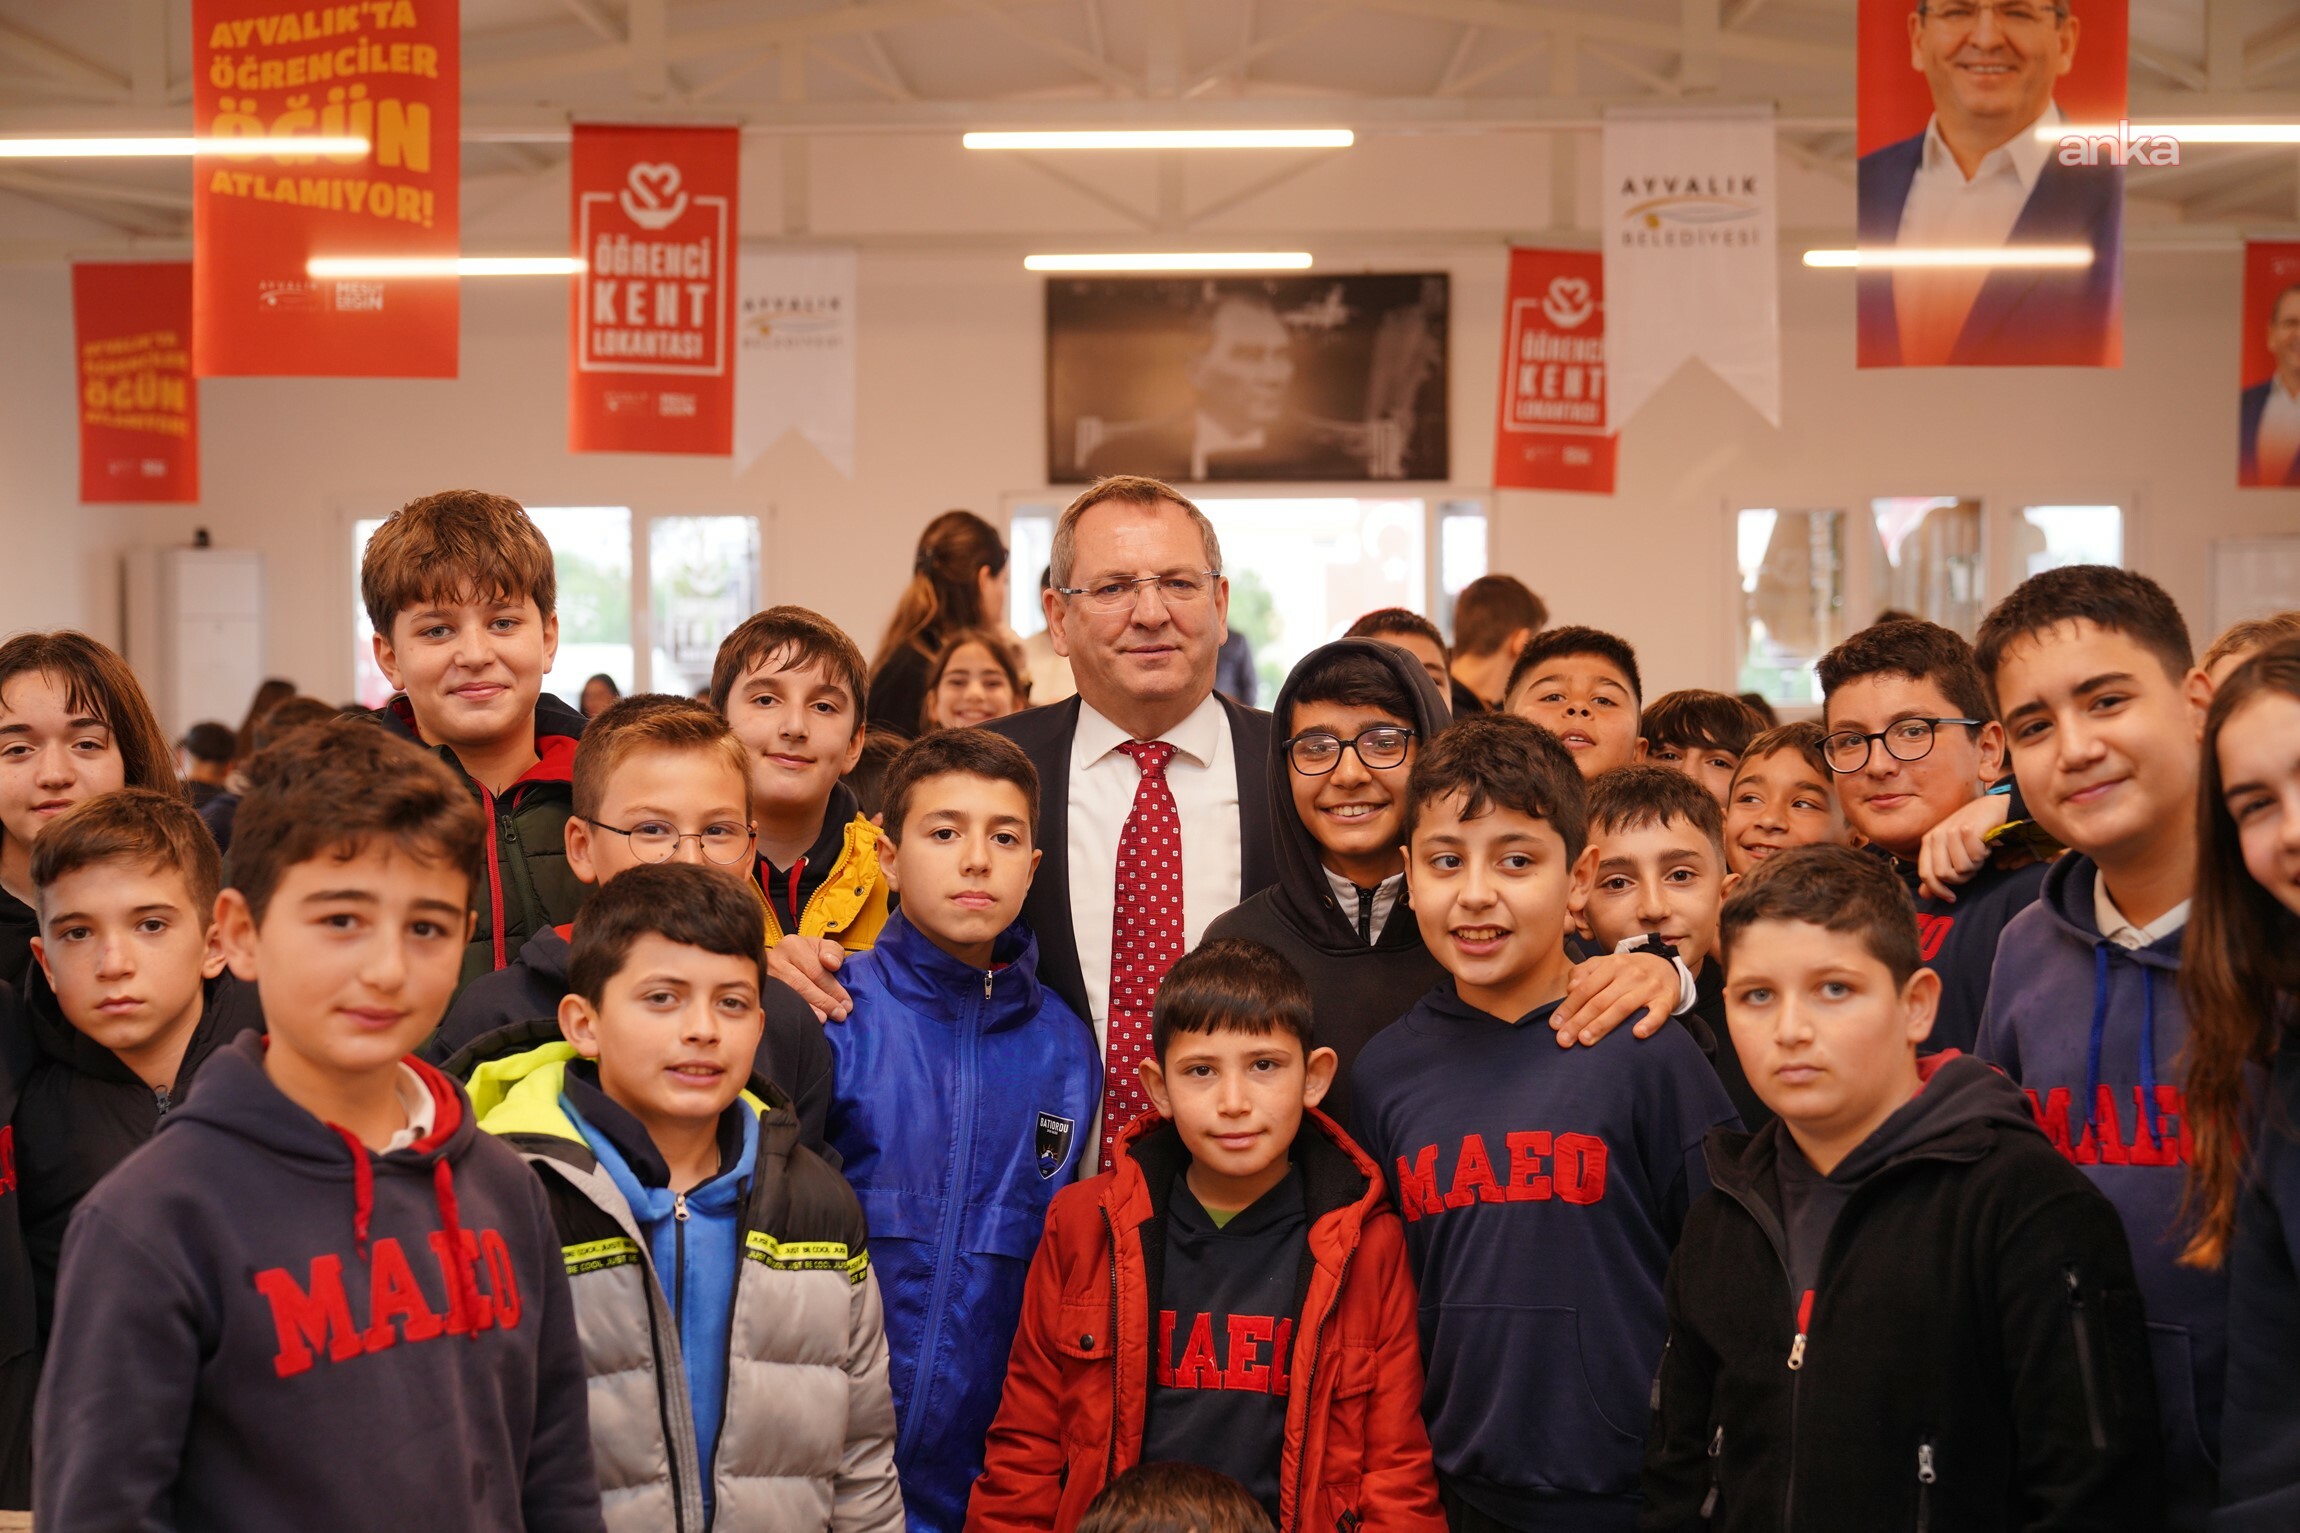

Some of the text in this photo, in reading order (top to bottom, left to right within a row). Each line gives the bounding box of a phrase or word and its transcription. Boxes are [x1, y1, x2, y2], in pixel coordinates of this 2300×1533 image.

[208, 0, 417, 49] AYVALIK'TA
[209, 36, 439, 90] ÖĞRENCİLER
[210, 82, 431, 174] ÖĞÜN
[210, 168, 435, 229] ATLAMIYOR!
[1621, 175, 1757, 196] AYVALIK
[594, 233, 712, 279] ÖĞRENCİ
[593, 280, 710, 328] KENT
[592, 328, 703, 360] LOKANTASI
[1520, 328, 1605, 362] ÖĞRENC
[1517, 363, 1606, 400] KENT
[1396, 1131, 1608, 1223] MAEO
[580, 1260, 604, 1272] COOL
[785, 1246, 800, 1254] JUST
[803, 1246, 811, 1254] BE
[813, 1246, 831, 1254] COOL
[804, 1260, 813, 1270] BE
[814, 1260, 832, 1270] COOL
[254, 1229, 521, 1378] MAEO
